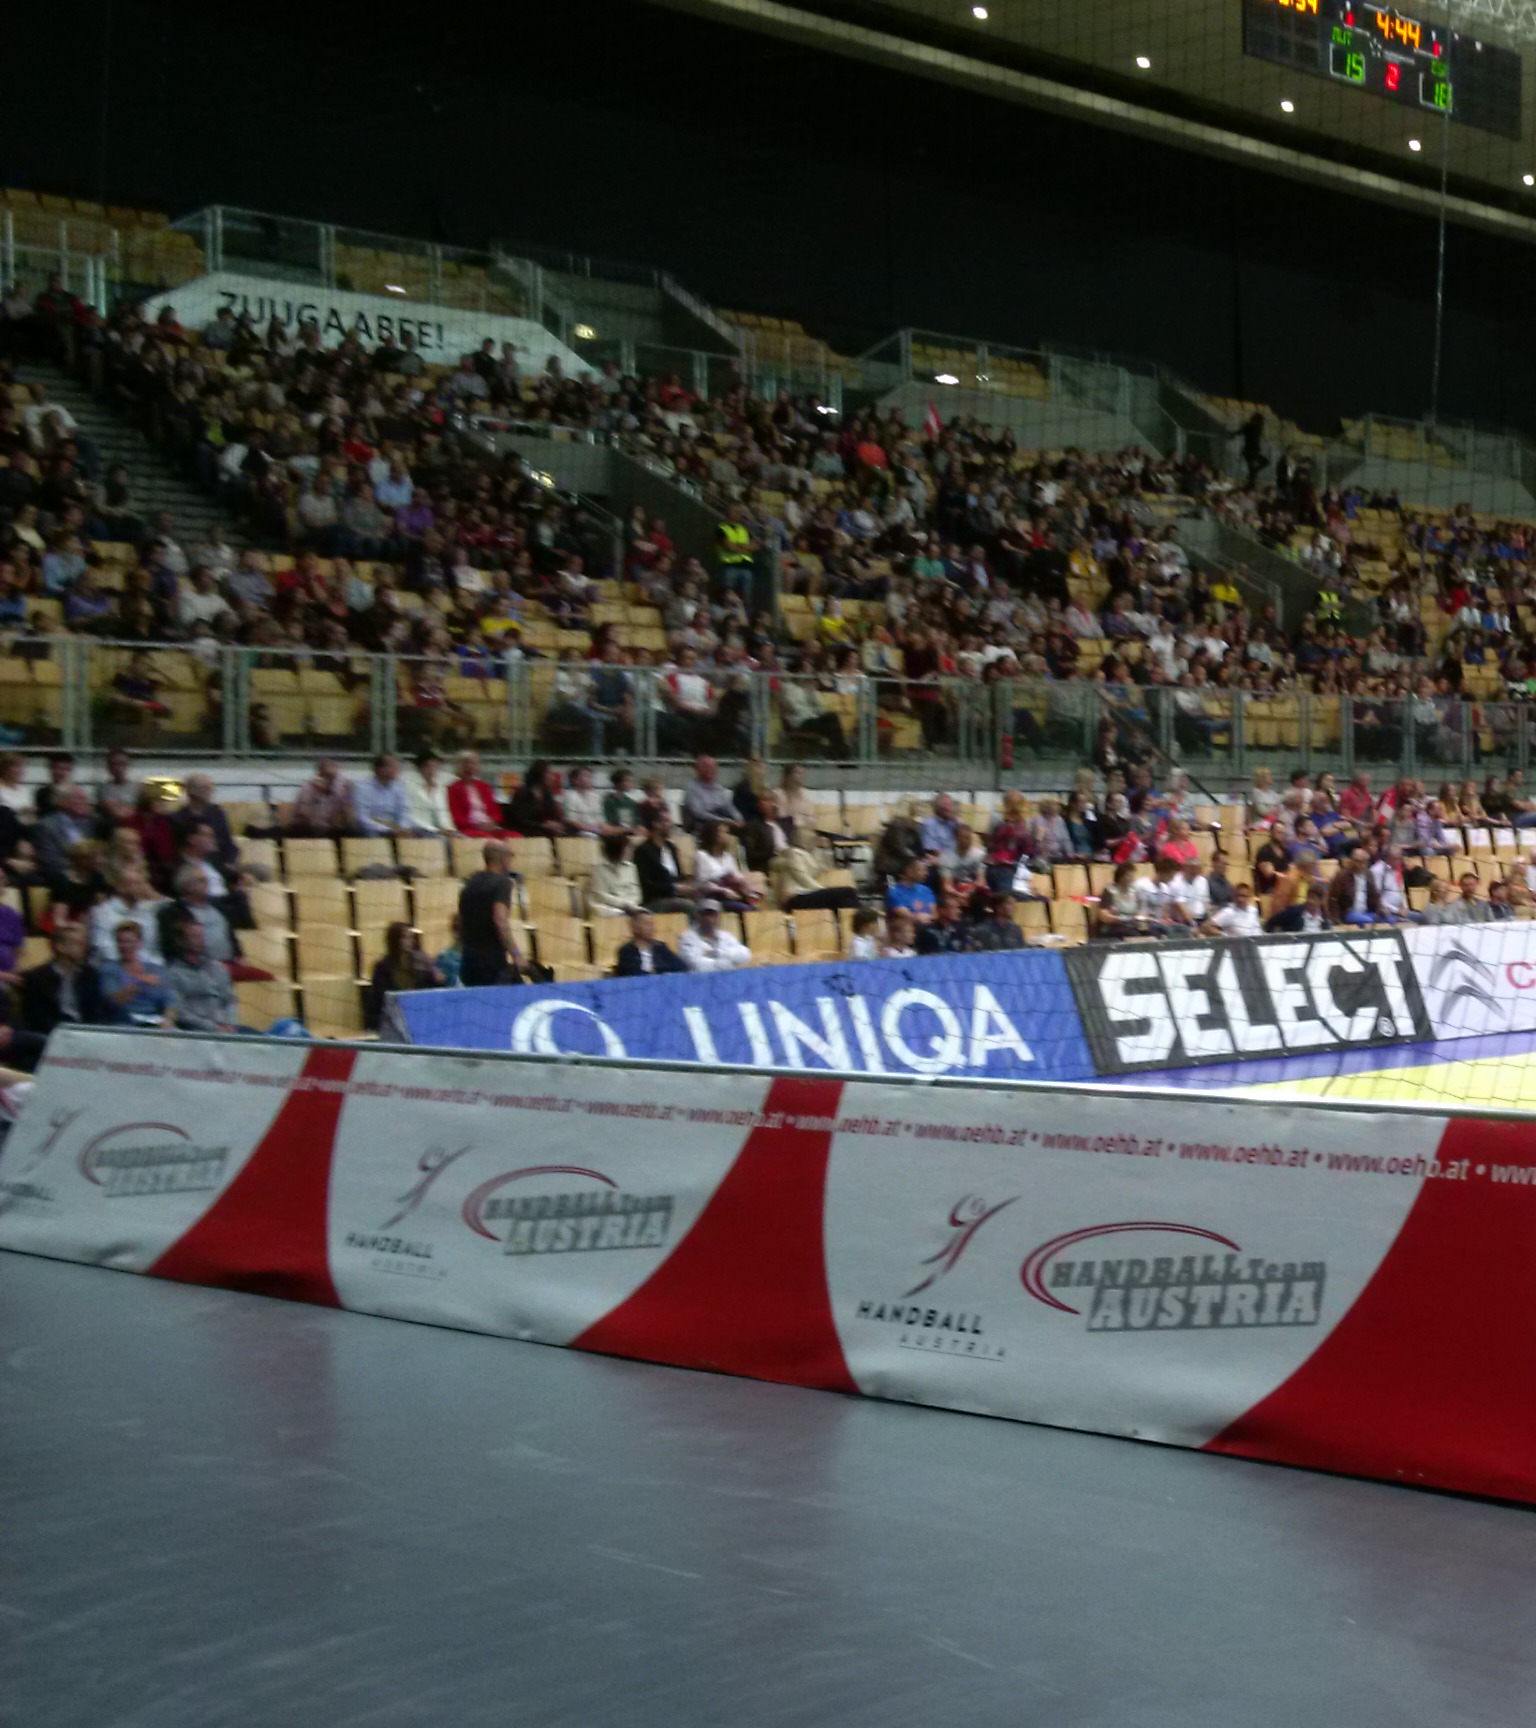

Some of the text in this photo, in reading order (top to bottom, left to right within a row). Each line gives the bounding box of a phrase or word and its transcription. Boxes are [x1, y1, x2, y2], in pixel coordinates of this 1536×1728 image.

[1376, 10, 1421, 50] 4:44
[1097, 936, 1417, 1065] SELECT
[682, 984, 1036, 1073] UNIQA
[1178, 1140, 1309, 1169] www.oehb.at
[1327, 1150, 1470, 1182] www.oehb.at
[1050, 1253, 1245, 1289] HANDBALL
[855, 1301, 983, 1335] HANDBALL
[1089, 1280, 1319, 1330] AUSTRIA
[899, 1333, 1006, 1357] AUSTRIA
